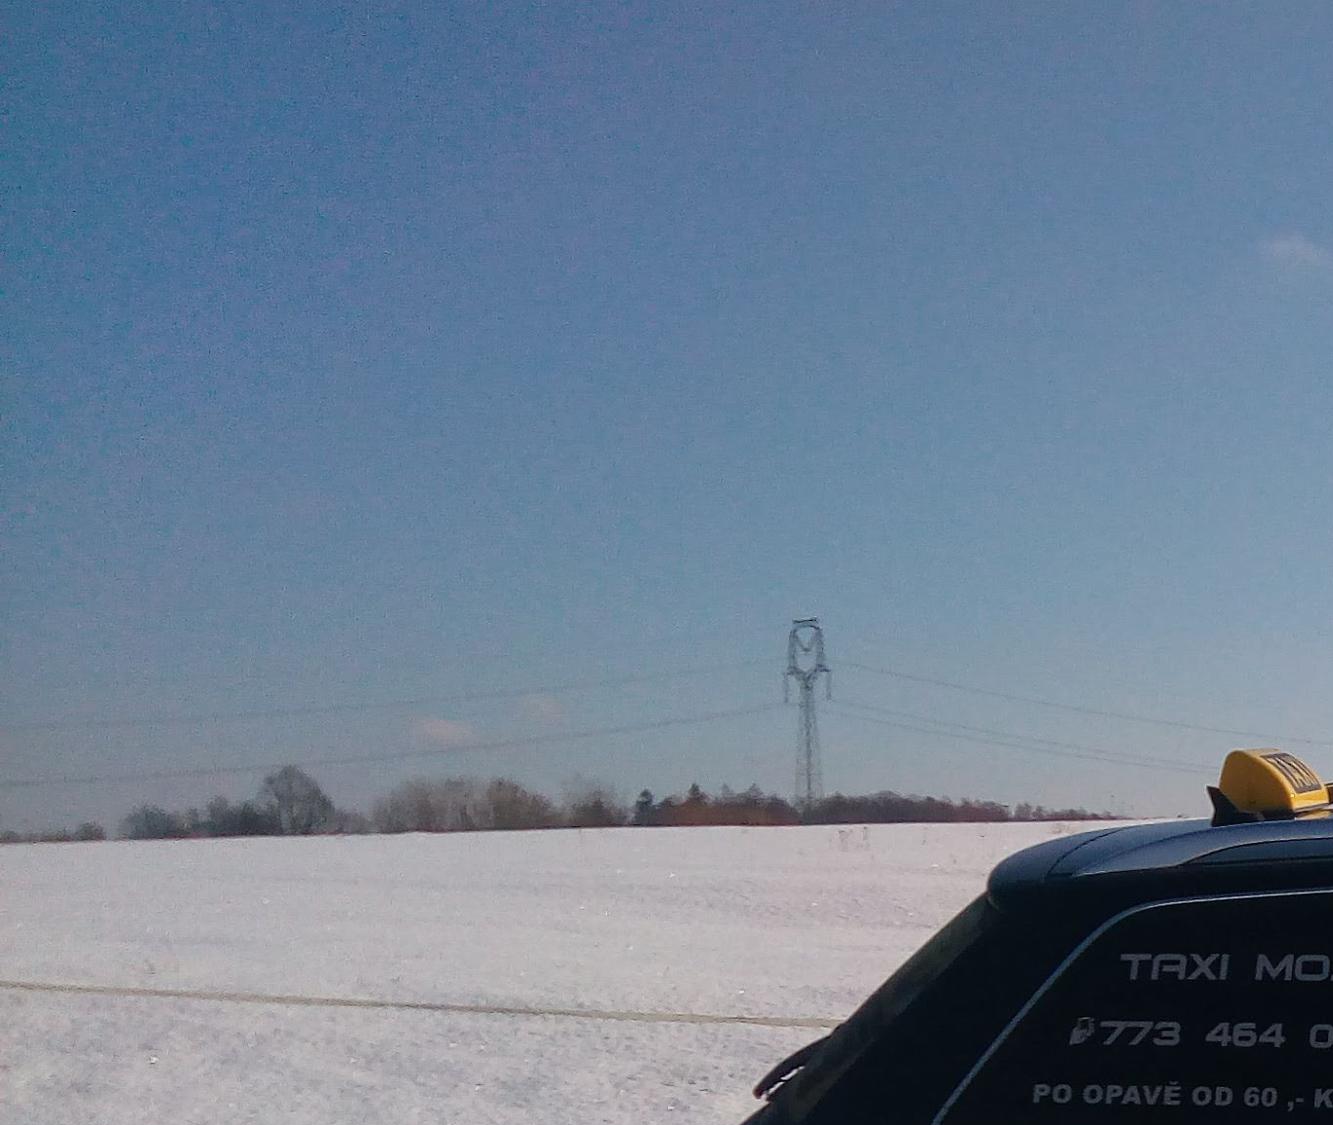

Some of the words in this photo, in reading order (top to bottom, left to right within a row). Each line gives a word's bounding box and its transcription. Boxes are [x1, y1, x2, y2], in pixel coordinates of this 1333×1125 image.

[1120, 953, 1229, 981] TAXI
[1099, 1020, 1182, 1047] 773
[1205, 1021, 1286, 1049] 464
[1032, 1083, 1072, 1105] PO
[1083, 1080, 1182, 1106] OPAVĚ
[1192, 1086, 1233, 1107] OD
